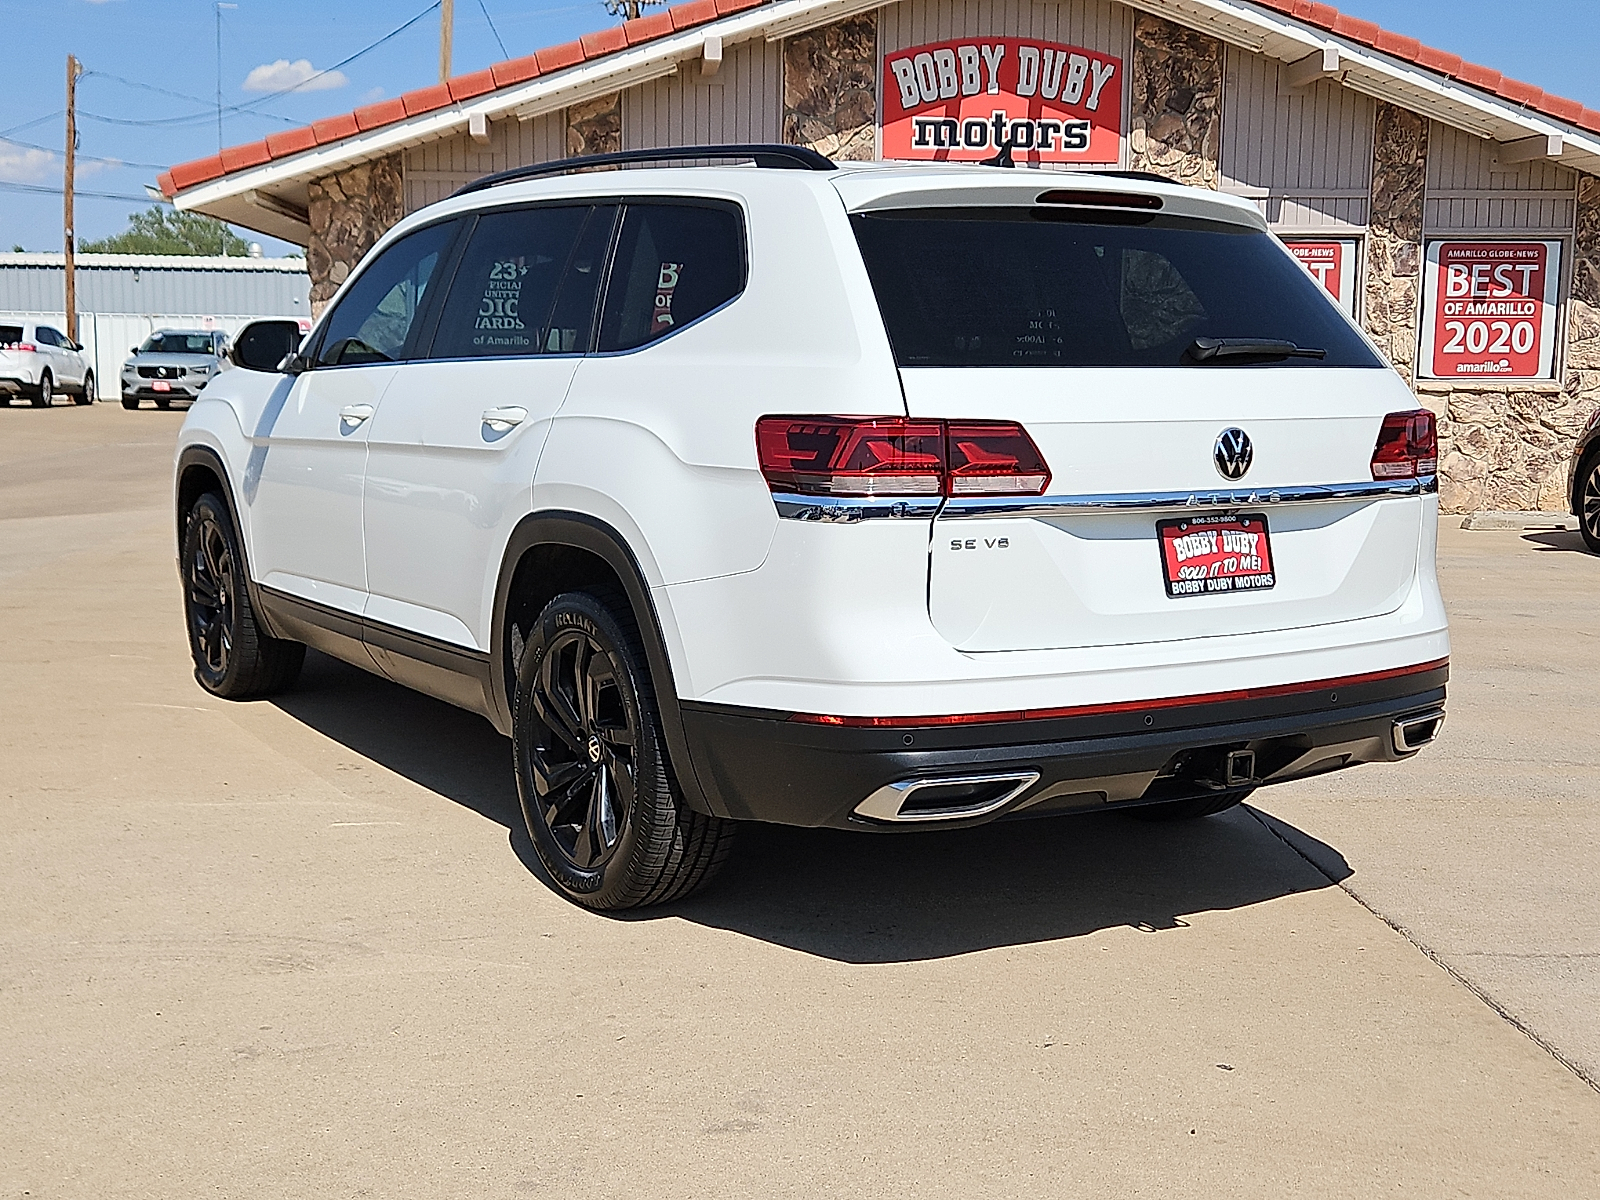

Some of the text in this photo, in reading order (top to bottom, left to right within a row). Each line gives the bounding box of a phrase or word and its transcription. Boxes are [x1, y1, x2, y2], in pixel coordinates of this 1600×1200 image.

[890, 44, 1115, 111] BOBBY DUBY
[912, 110, 1092, 152] motors
[1293, 248, 1335, 257] OBE-NEWS
[1447, 249, 1539, 258] AMARILLO GLOBE-NEWS
[1446, 264, 1539, 297] BEST
[1444, 302, 1536, 315] OF AMARILLO
[475, 317, 526, 329] ARDS
[473, 335, 530, 345] of Amarillo
[1442, 320, 1535, 354] 2020
[1186, 490, 1280, 507] ATLAS
[950, 537, 1009, 551] SE V6
[1172, 529, 1259, 562] BOBBY DUBY
[1178, 555, 1262, 580] SOLD IT TO ME!
[1171, 574, 1274, 595] BOBBY DUBY MOTORS
